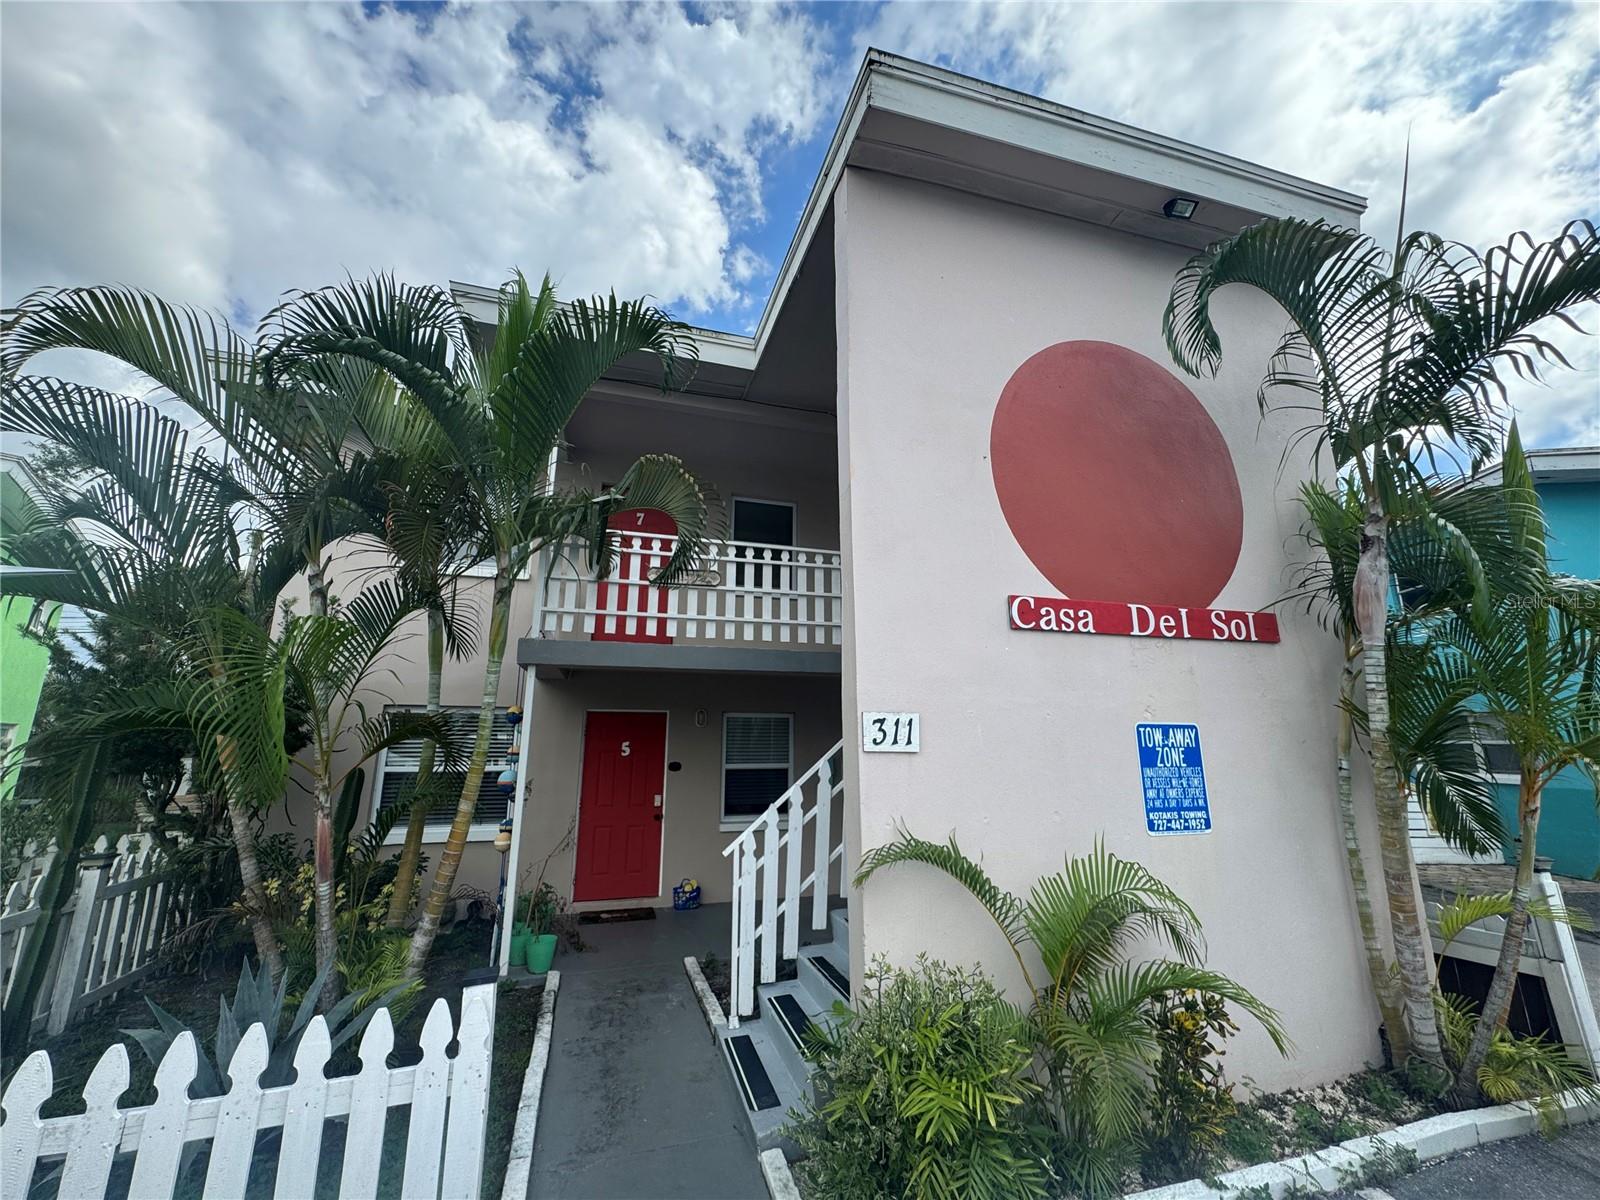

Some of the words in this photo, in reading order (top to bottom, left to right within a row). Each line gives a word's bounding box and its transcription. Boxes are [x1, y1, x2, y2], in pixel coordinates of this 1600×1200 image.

[636, 512, 645, 526] 7
[1011, 596, 1096, 633] Casa
[1127, 603, 1191, 639] Del
[1210, 610, 1258, 641] Sol
[872, 717, 913, 746] 311
[1139, 727, 1162, 747] TOW
[1168, 728, 1196, 747] AWAY
[621, 741, 631, 756] 5
[1156, 747, 1187, 767] ZONE
[1149, 811, 1179, 820] KOTAKIS
[1180, 810, 1208, 819] TOWING
[1153, 818, 1206, 831] 727-447-1952
